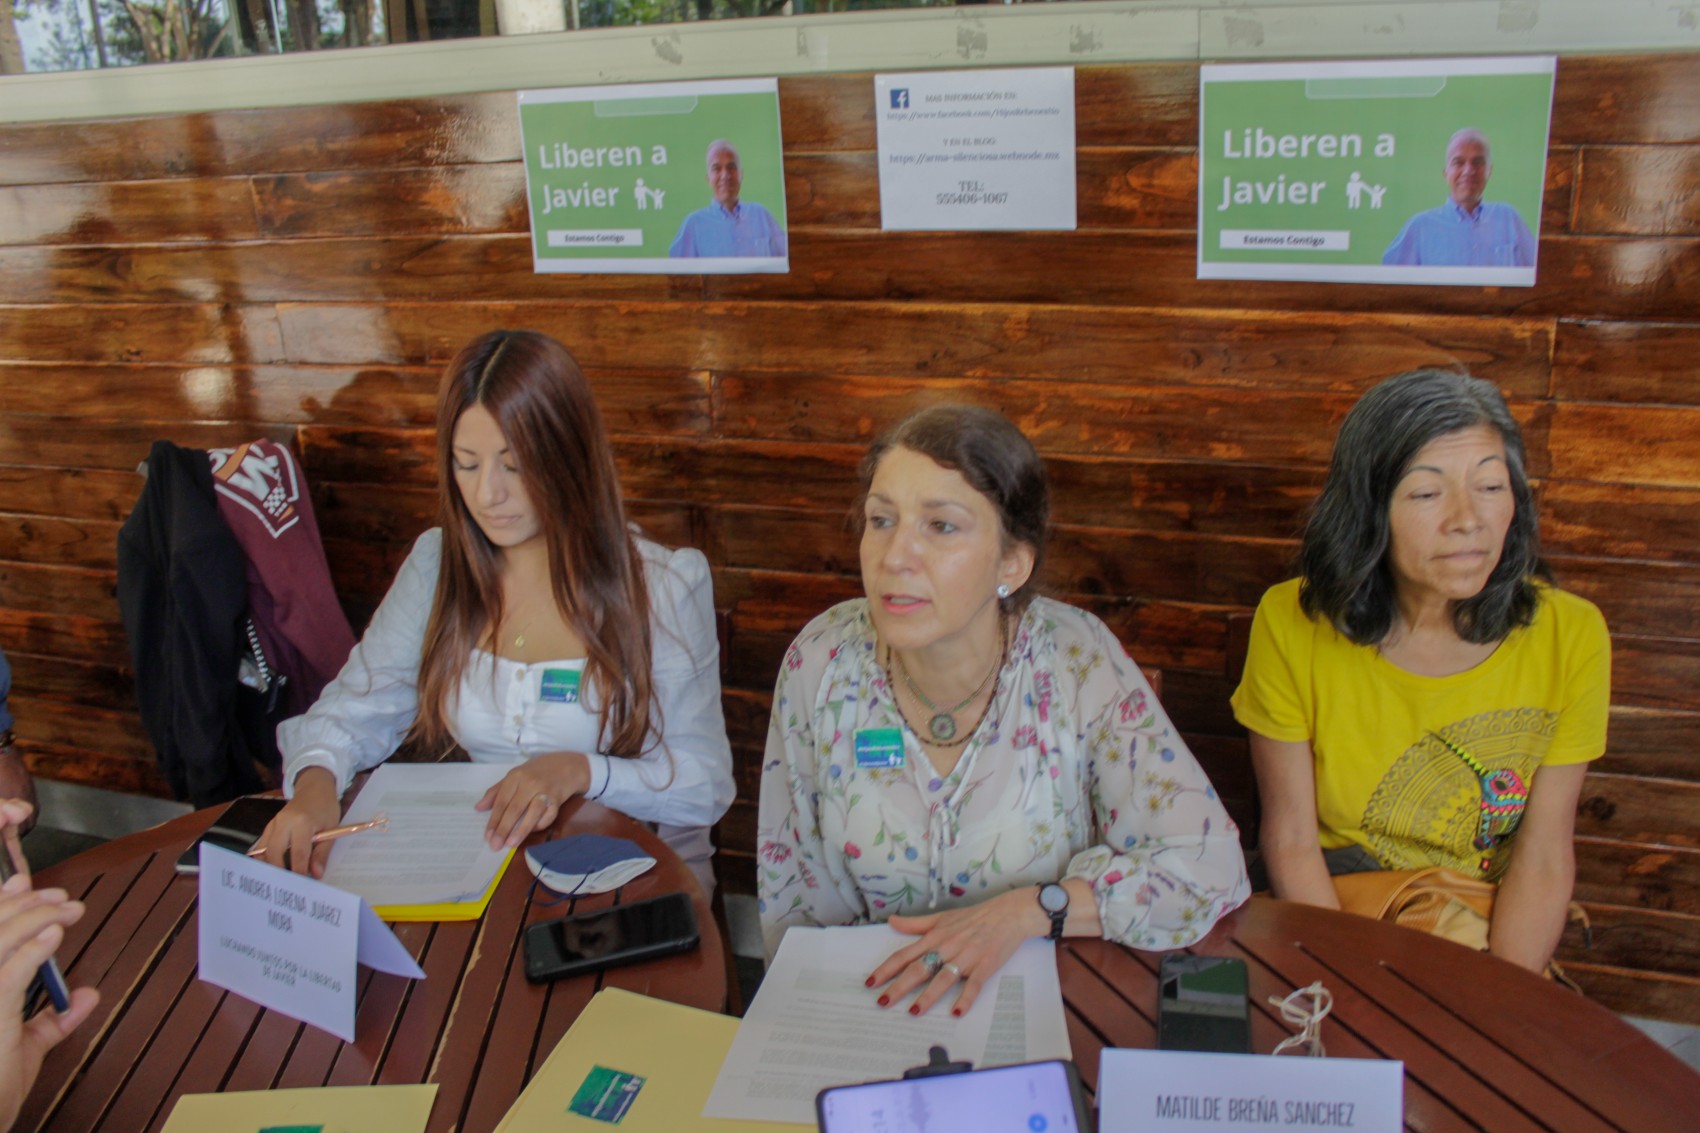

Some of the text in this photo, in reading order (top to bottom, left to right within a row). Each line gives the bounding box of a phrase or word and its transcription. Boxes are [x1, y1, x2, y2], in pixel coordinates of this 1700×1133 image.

[539, 143, 667, 169] Liberen a
[1223, 128, 1396, 158] Liberen a
[542, 182, 619, 214] Javier
[958, 180, 985, 192] TEL:
[1217, 174, 1326, 211] Javier
[564, 233, 624, 244] Estamos Contigo
[1243, 235, 1325, 246] Estamos Contigo
[239, 873, 271, 901] ANDREA
[1156, 1095, 1355, 1127] MATILDE BREÑA SANCHEZ
